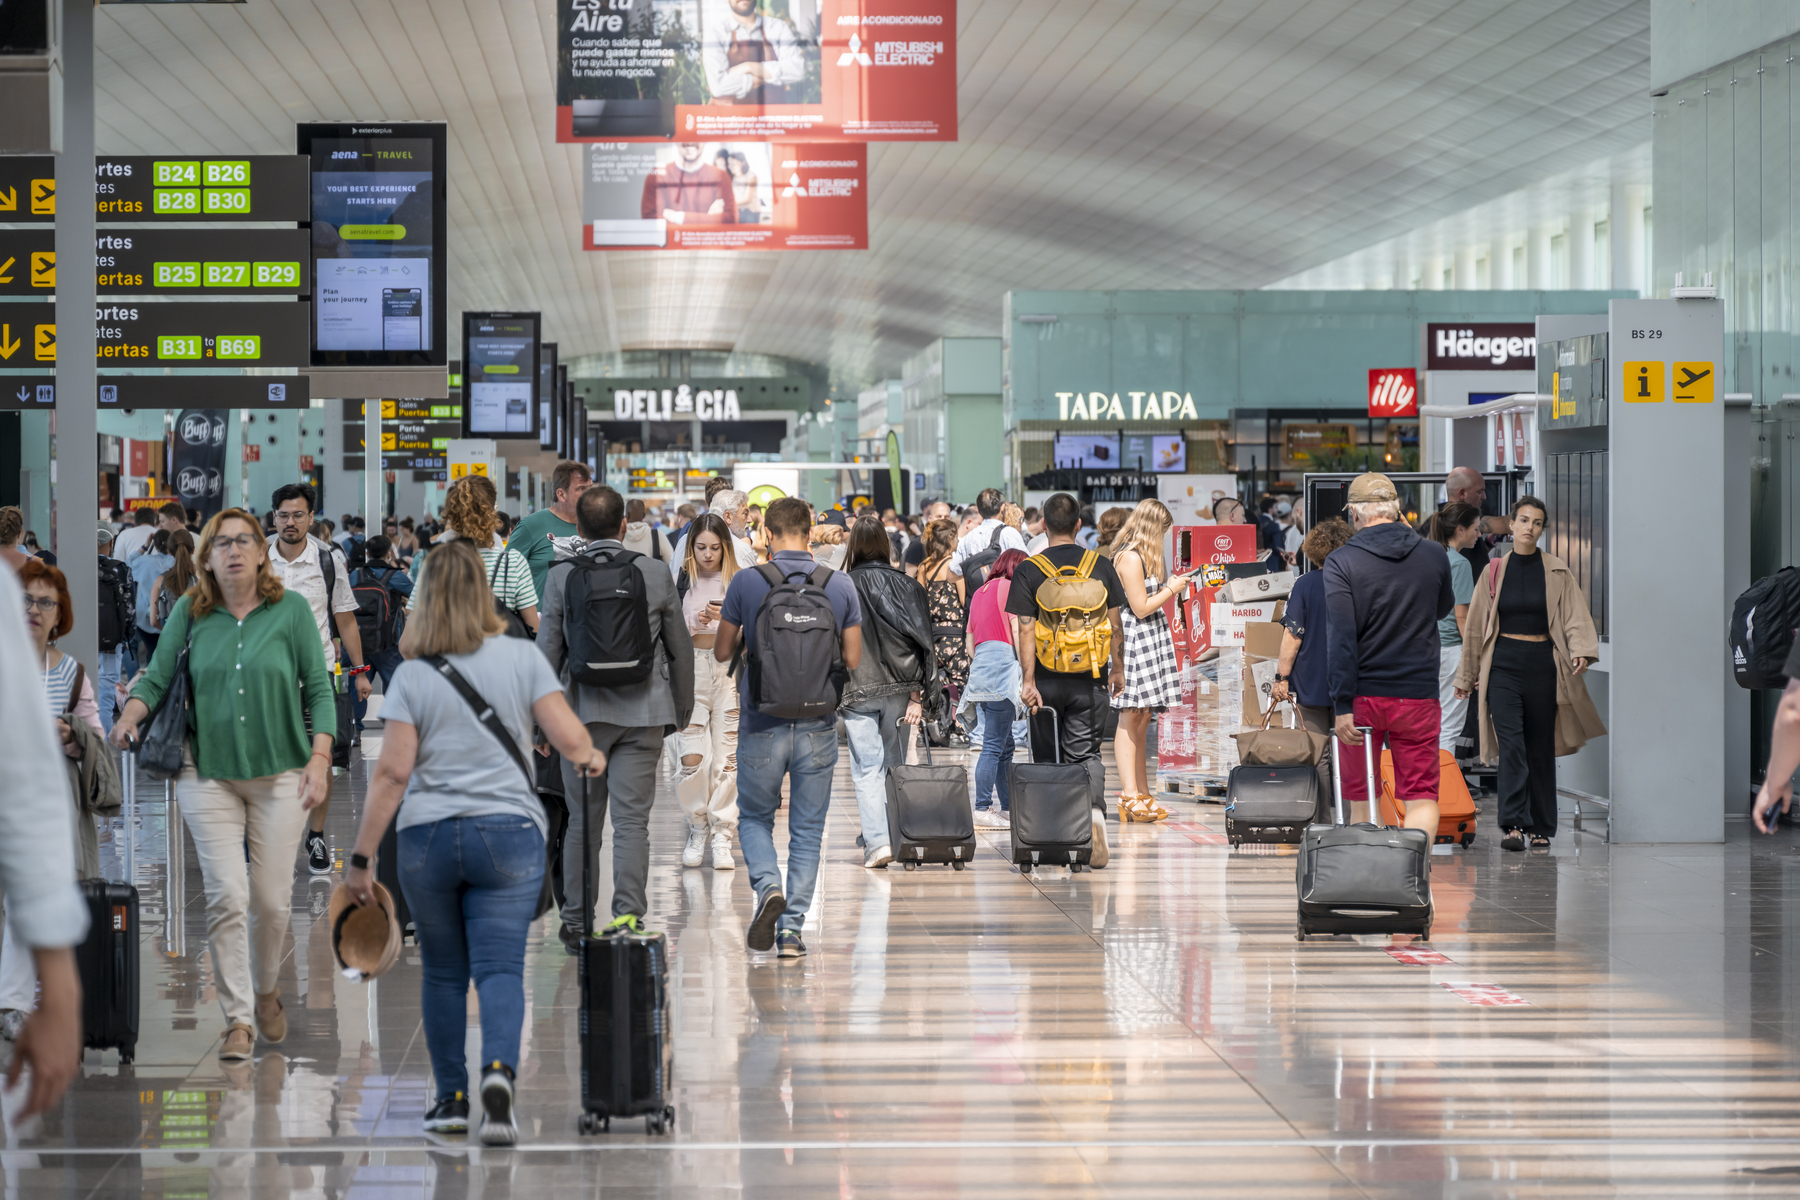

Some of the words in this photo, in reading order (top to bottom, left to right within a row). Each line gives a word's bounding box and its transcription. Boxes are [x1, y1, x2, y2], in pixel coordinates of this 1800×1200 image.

[570, 10, 623, 32] Aire
[837, 15, 860, 25] AIRE
[861, 15, 943, 25] ACONDICIONADO
[571, 37, 610, 47] Cuando
[611, 37, 640, 47] sabes
[642, 39, 662, 48] que
[875, 41, 943, 53] MITSUBISHI
[572, 48, 604, 58] puede
[605, 48, 639, 58] gastar
[640, 49, 675, 57] menos
[875, 53, 934, 65] ELECTRIC
[572, 60, 578, 68] y
[579, 58, 588, 67] te
[589, 58, 619, 68] ayuda
[627, 58, 660, 67] ahorrar
[572, 68, 582, 77] tu
[584, 69, 613, 77] nuevo
[615, 67, 656, 78] negocio.
[331, 151, 358, 159] aena
[377, 151, 413, 159] TRAVEL
[95, 162, 132, 177] rtes
[158, 165, 196, 182] B24
[208, 165, 246, 182] B26
[95, 181, 115, 194] tes
[158, 192, 196, 209] B28
[208, 192, 246, 209] B30
[96, 236, 133, 250] rtes
[96, 255, 115, 267] tes
[158, 265, 196, 283] B25
[208, 265, 246, 283] B27
[258, 265, 295, 283] B29
[96, 306, 139, 321] ortes
[96, 326, 122, 339] ates
[1632, 329, 1645, 339] BS
[1648, 329, 1662, 339] 29
[96, 343, 149, 357] uertas
[162, 339, 197, 355] B31
[204, 337, 214, 347] to
[220, 339, 256, 355] B69
[1436, 329, 1536, 365] Häagen
[206, 349, 213, 357] a
[1371, 373, 1415, 413] illy
[399, 401, 417, 409] Gates
[614, 389, 672, 421] DELI
[674, 384, 694, 412] &
[1055, 391, 1126, 421] TAPA
[1128, 391, 1199, 420] TAPA
[399, 408, 429, 417] Puertas
[433, 407, 449, 416] B33
[399, 424, 425, 433] Portes
[399, 433, 417, 441] Gates
[399, 440, 429, 449] Puertas
[1086, 476, 1107, 486] BAR
[1110, 476, 1123, 486] DE
[1210, 552, 1236, 564] Chips
[1232, 608, 1262, 617] HARIBO
[1233, 631, 1245, 639] HA
